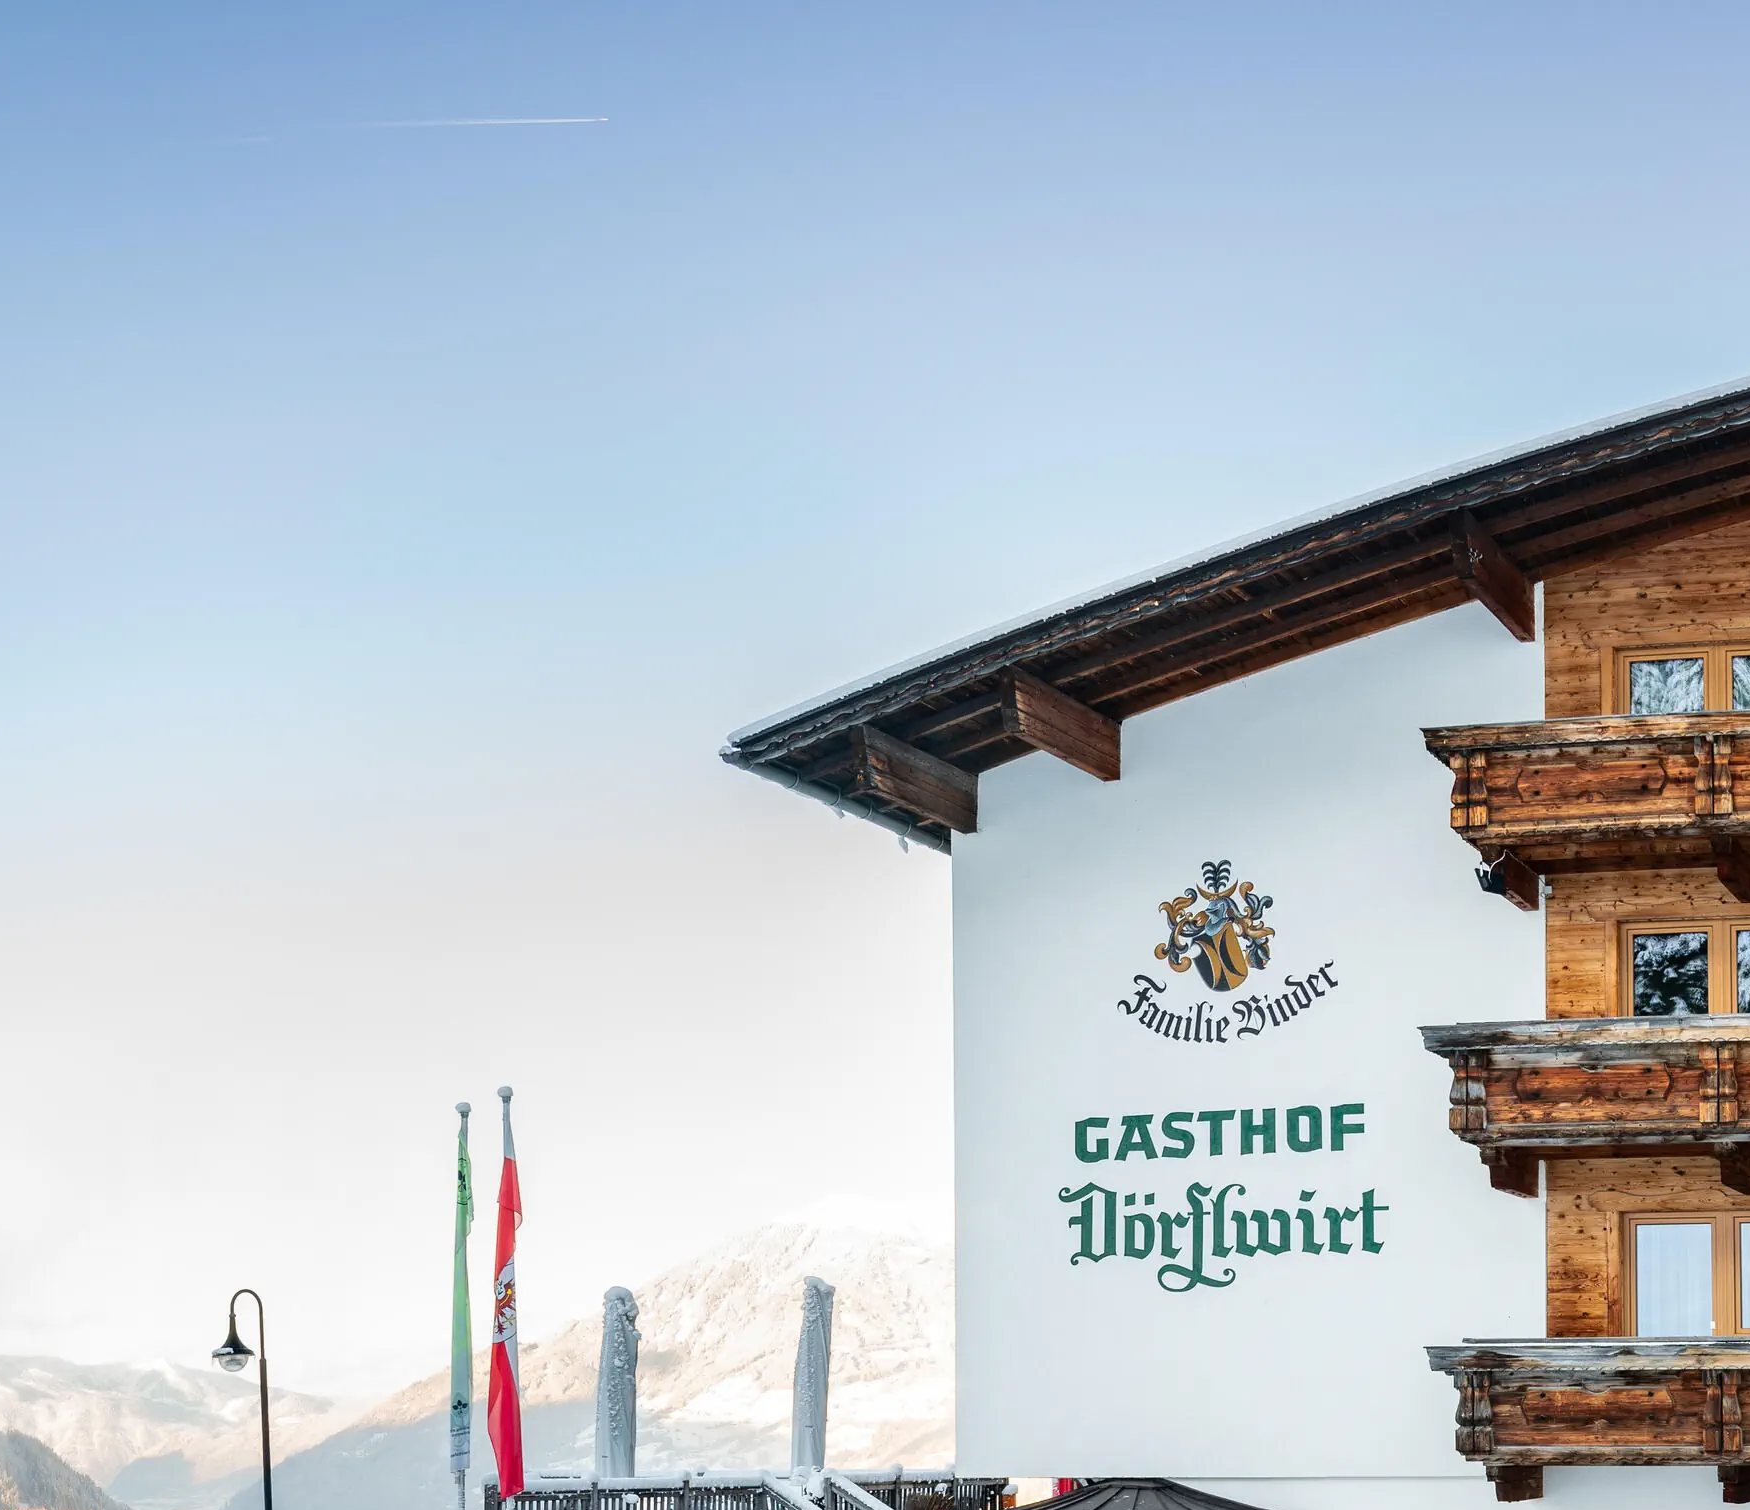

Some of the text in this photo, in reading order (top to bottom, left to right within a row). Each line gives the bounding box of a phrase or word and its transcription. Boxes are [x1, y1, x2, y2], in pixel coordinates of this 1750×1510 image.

[1116, 959, 1339, 1043] Familie Binder
[1074, 1102, 1365, 1163] GASTHOF
[1058, 1181, 1390, 1293] Dörflwirt
